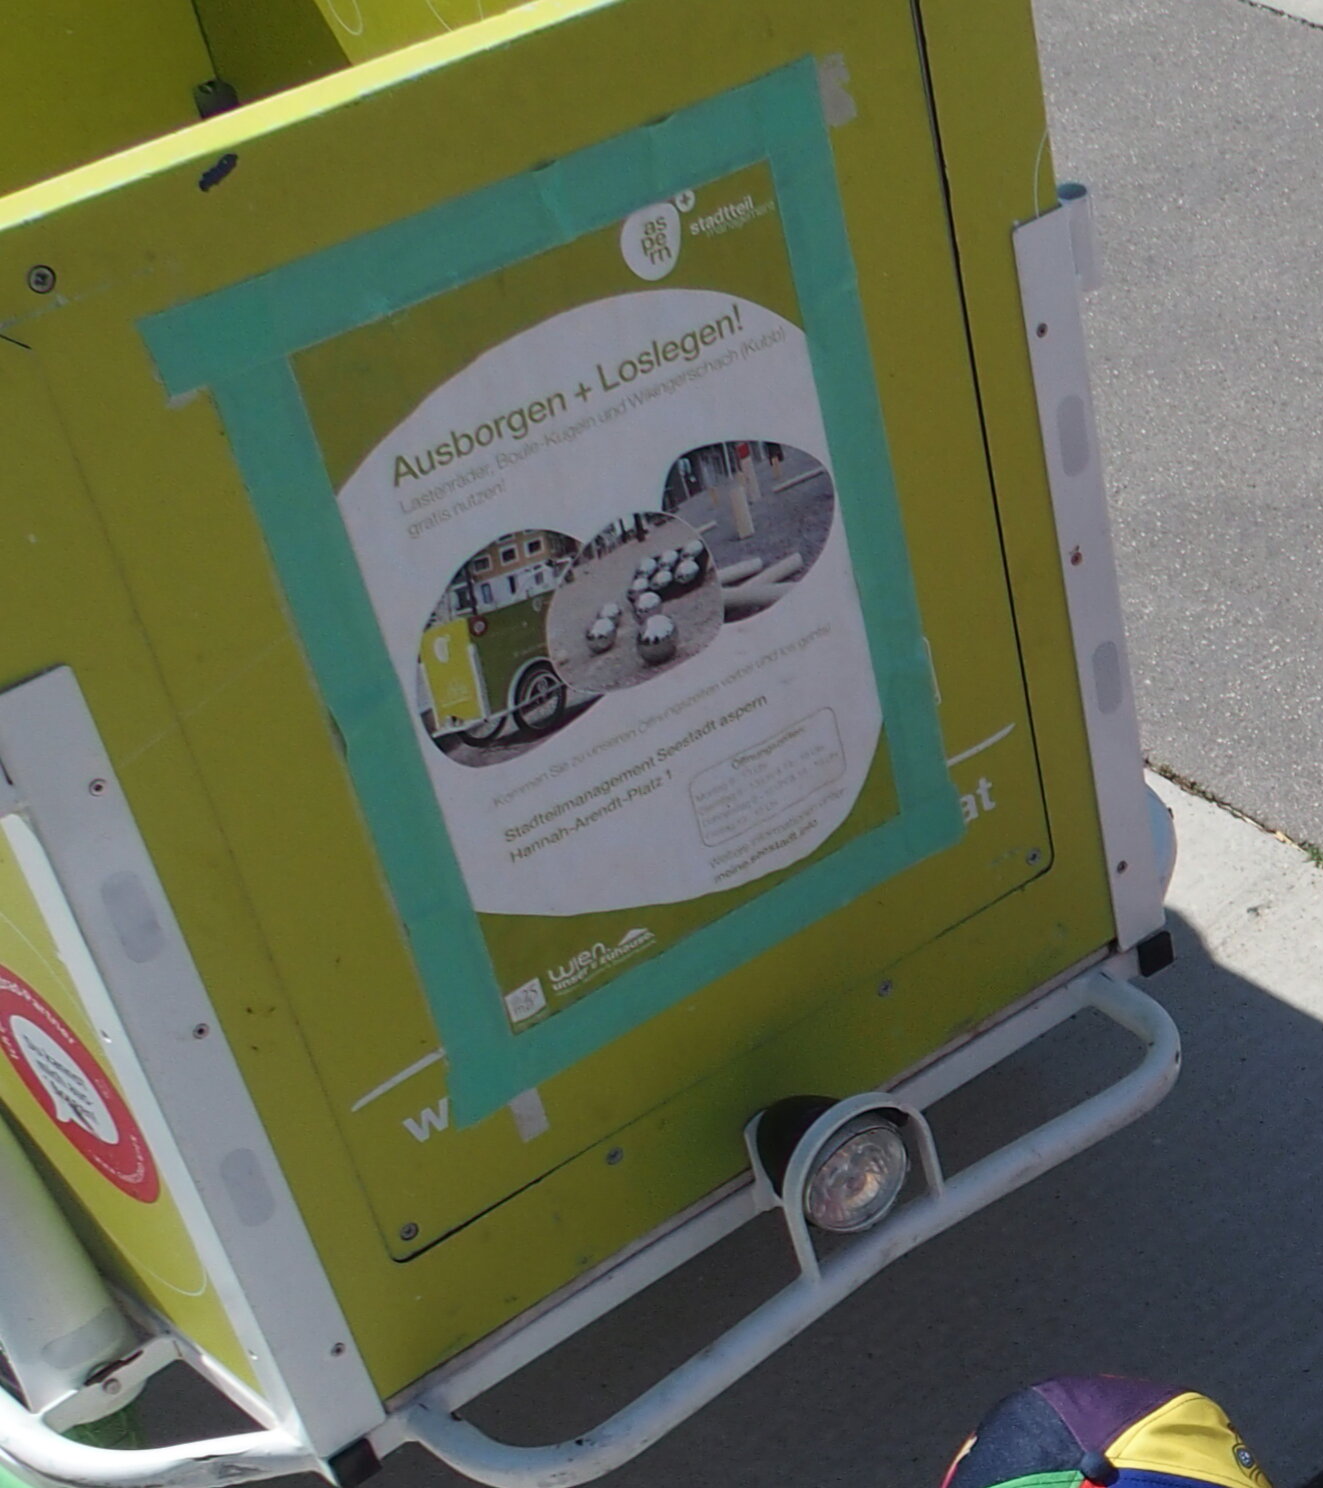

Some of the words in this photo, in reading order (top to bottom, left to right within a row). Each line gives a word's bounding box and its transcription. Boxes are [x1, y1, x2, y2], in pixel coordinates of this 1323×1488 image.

[690, 195, 754, 236] stadtteil
[393, 392, 567, 488] Ausborgen
[574, 382, 592, 402] +
[596, 303, 743, 393] Loslegen!
[656, 719, 718, 763] Seestadt
[719, 695, 768, 728] aspern
[509, 775, 664, 864] Hannah-Arendt-Platz
